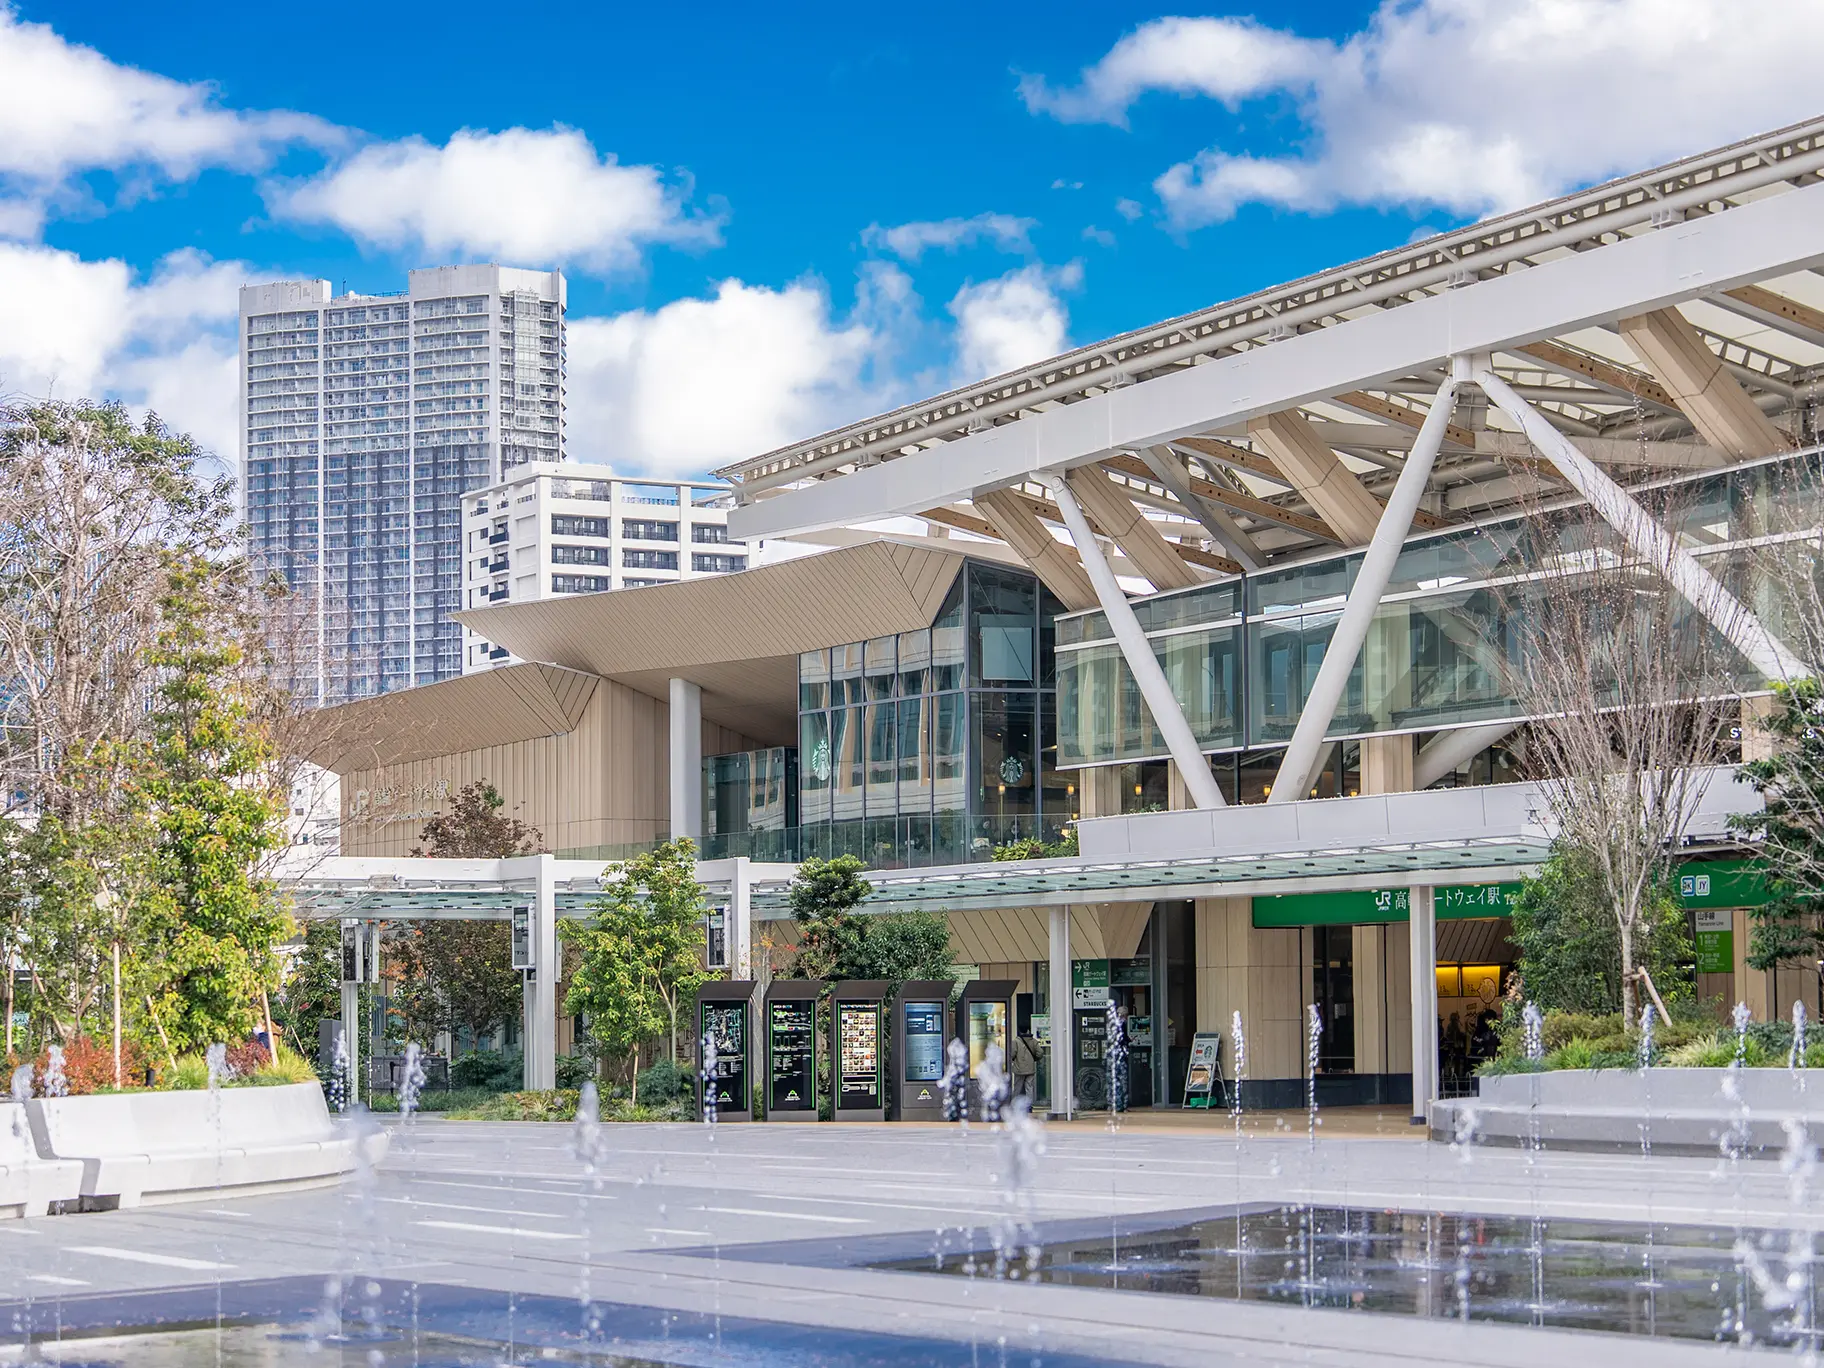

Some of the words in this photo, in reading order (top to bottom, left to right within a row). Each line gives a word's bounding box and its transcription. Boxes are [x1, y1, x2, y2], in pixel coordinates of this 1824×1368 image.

[1375, 891, 1391, 906] JR
[1395, 886, 1500, 910] 高ートウェイ駅
